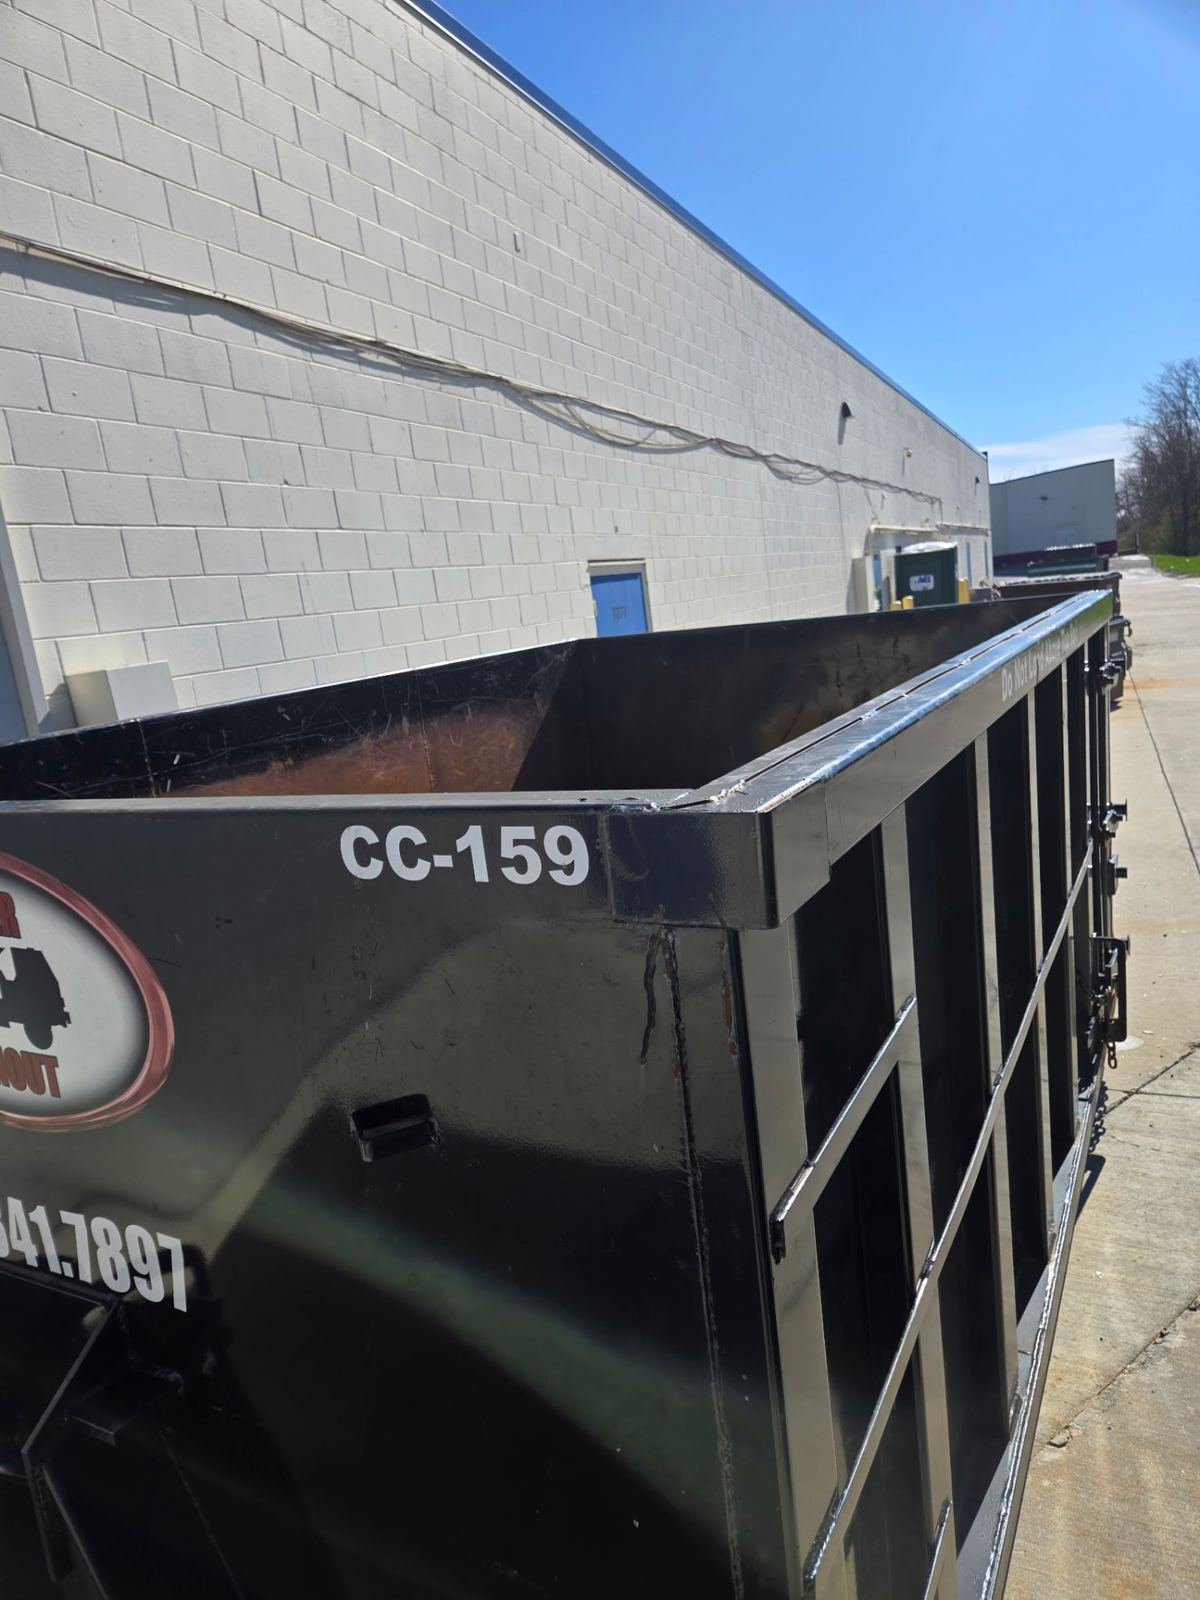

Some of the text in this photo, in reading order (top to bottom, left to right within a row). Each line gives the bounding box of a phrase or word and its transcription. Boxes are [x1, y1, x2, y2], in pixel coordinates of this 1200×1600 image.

[1002, 667, 1013, 702] Do
[1014, 655, 1028, 691] Not
[340, 825, 589, 886] CC-159
[0, 891, 21, 939] R
